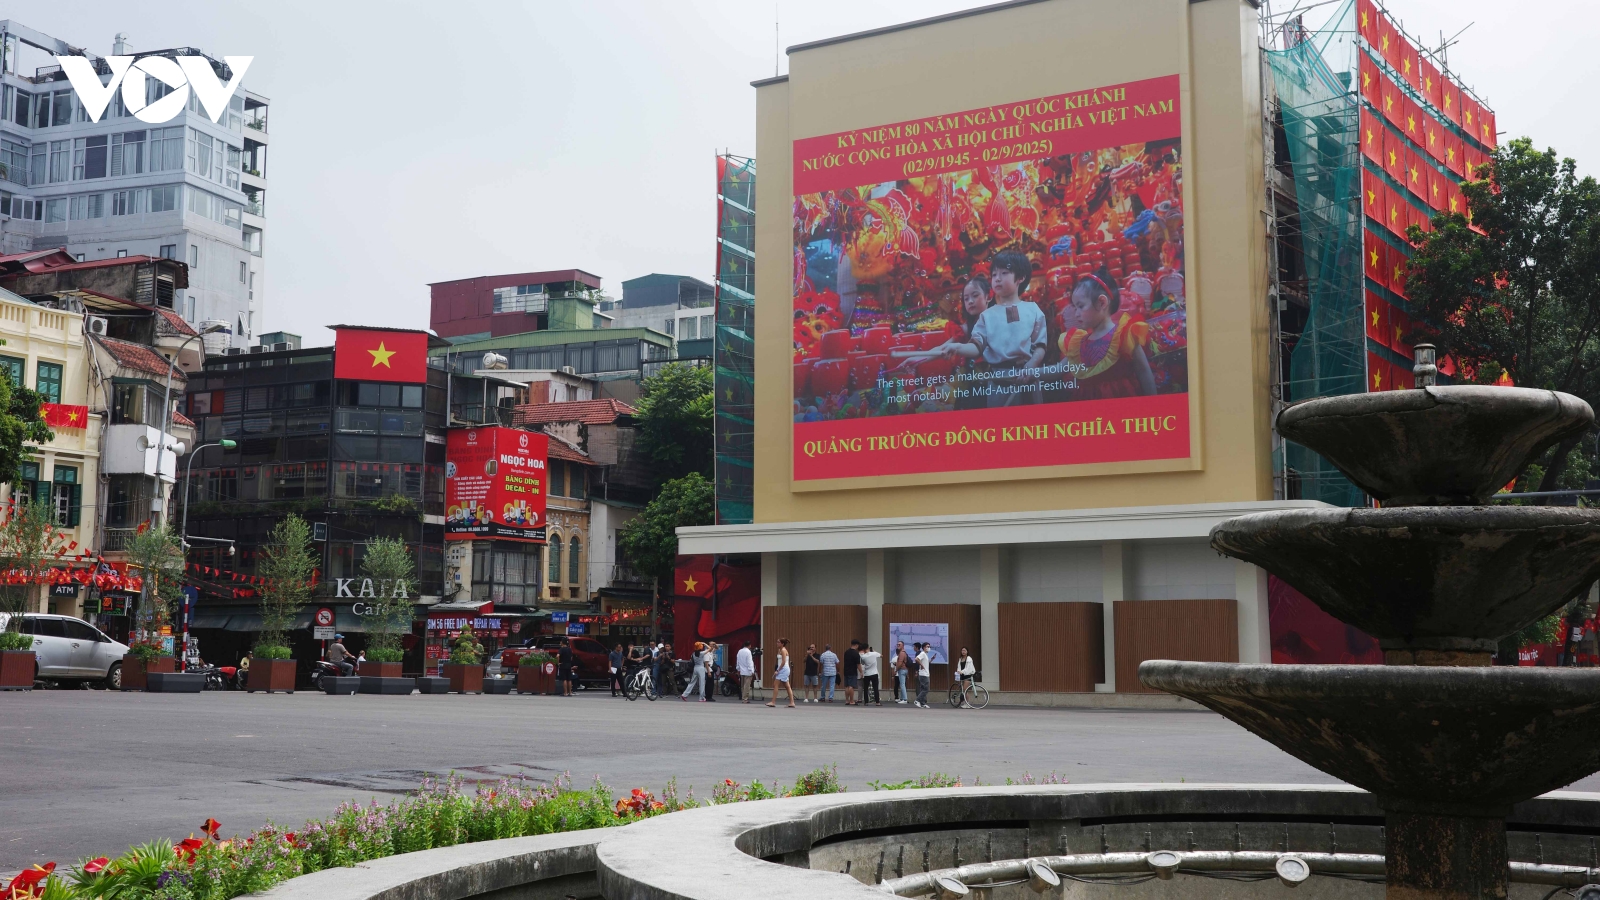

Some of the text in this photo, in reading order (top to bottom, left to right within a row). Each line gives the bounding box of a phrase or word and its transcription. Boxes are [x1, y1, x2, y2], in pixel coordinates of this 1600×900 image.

[838, 87, 1126, 148] KỶ NIỆM 80 NĂM NGÀY QUỐC KHÁNH
[802, 99, 1174, 172] NƯỚC CỘNG HÒA XÃ HỘI CHỦ NGHĨA VIỆT NAM
[903, 152, 970, 176] (02/9/1945
[982, 139, 1053, 163] 02/9/2025)
[876, 378, 894, 389] The
[896, 376, 924, 387] street
[926, 374, 947, 388] gets
[957, 369, 1006, 382] makeover
[1008, 365, 1040, 379] during
[1043, 362, 1088, 375] holidays,
[887, 378, 1080, 404] most notably the Mid-Autumn Festival,
[803, 415, 1177, 458] QUẢNG TRƯỜNG ĐÔNG KINH NGHĨA THỤC
[500, 454, 545, 469] NGỌC HOA
[505, 484, 526, 493] DECAL
[532, 487, 539, 495] IN
[55, 586, 74, 594] ATM
[427, 618, 437, 630] SIM
[437, 619, 443, 629] 5G
[444, 618, 455, 629] FREE
[473, 618, 488, 629] REPAIR
[489, 618, 502, 629] PHONE
